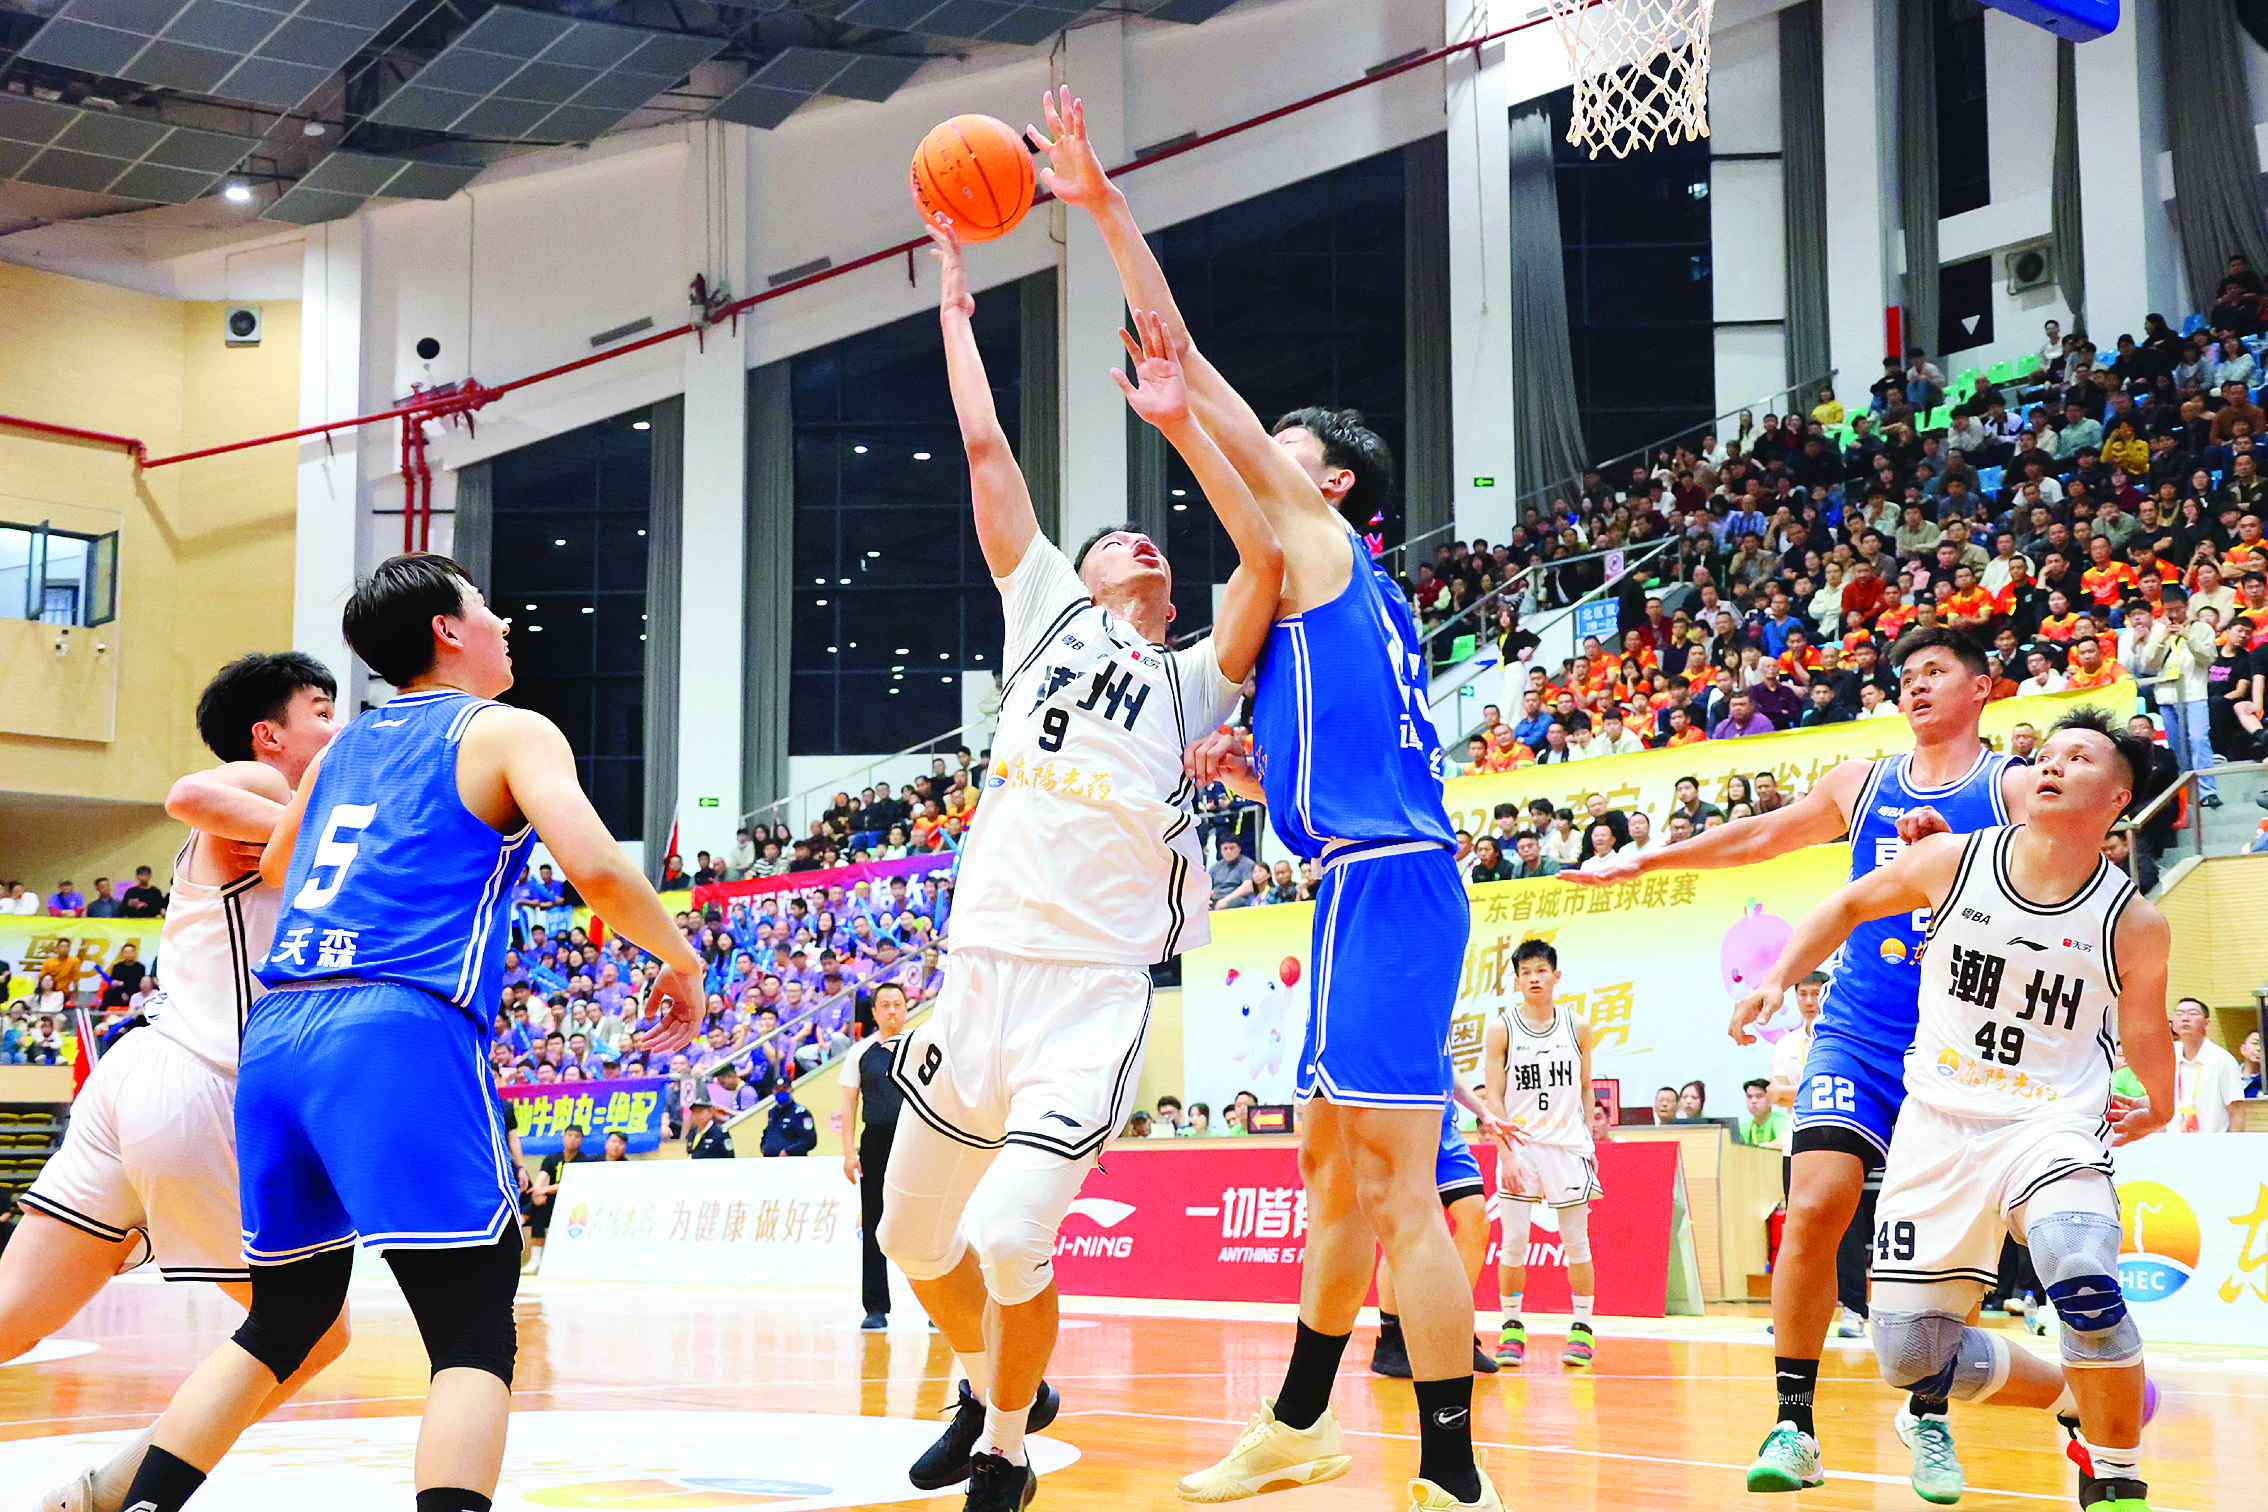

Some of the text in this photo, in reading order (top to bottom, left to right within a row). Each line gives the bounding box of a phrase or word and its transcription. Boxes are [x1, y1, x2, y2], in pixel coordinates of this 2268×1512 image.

[1039, 708, 1069, 752] 9
[294, 803, 378, 910] 5
[1961, 907, 1991, 925] 粤BA
[1949, 943, 2084, 1031] 潮州
[1975, 1020, 2024, 1066] 49
[918, 1044, 942, 1086] 9
[1515, 1060, 1572, 1091] 潮州
[1538, 1092, 1549, 1111] 6
[1811, 1075, 1855, 1112] 22
[1218, 1246, 1280, 1263] ANYTHING
[1281, 1247, 1296, 1263] IS
[1877, 1221, 1915, 1260] 49
